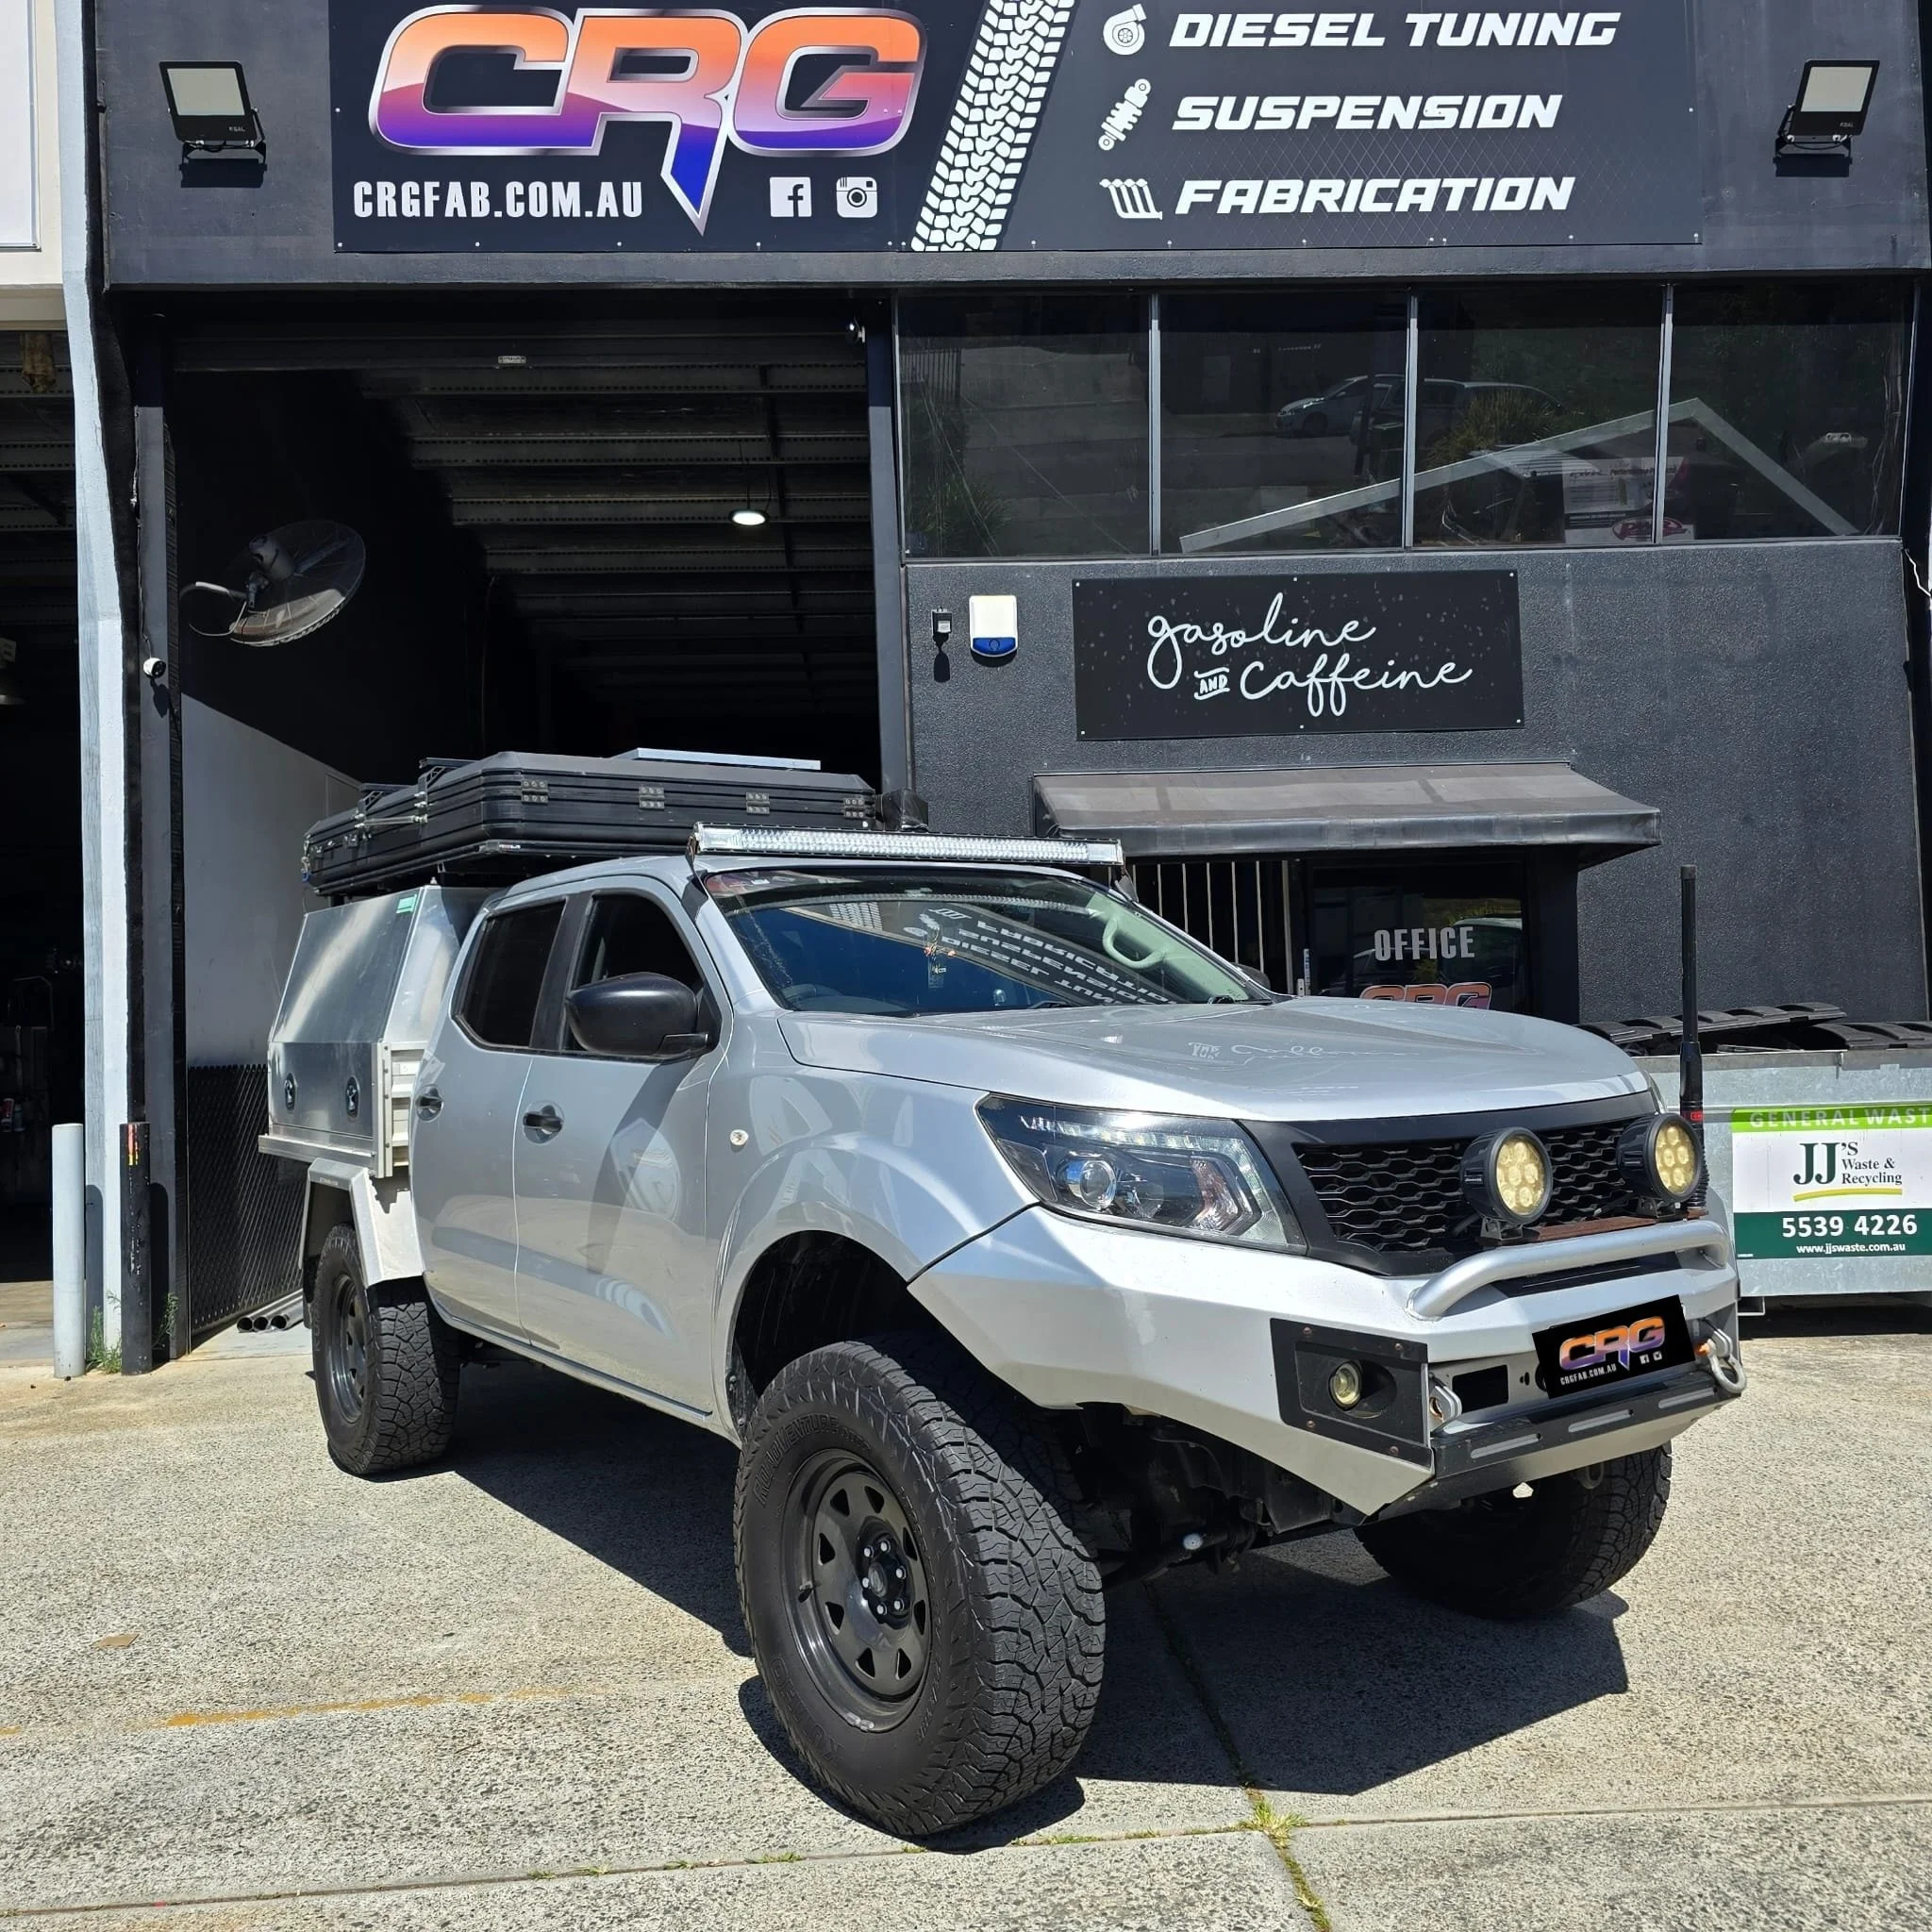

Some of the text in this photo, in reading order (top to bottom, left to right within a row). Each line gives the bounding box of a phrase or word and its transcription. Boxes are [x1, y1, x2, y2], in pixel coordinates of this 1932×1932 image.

[1168, 11, 1622, 48] DIESEL TUNING
[368, 4, 927, 236] CRG
[1172, 93, 1564, 130] SUSPENSION
[353, 179, 643, 220] CRGFAB.COM.AU
[1174, 176, 1576, 215] FABRICATION
[1146, 592, 1376, 690] gasoline
[1196, 671, 1228, 696] AND
[1374, 926, 1475, 961] OFFICE
[1749, 1109, 1859, 1128] GENERAL
[1840, 1158, 1895, 1170] Waste &
[1840, 1172, 1903, 1186] Recycling
[1782, 1214, 1918, 1238] 5539 4226
[1796, 1242, 1906, 1255] www.jjswaste.com.au
[1559, 1316, 1666, 1372] CRG
[1559, 1363, 1618, 1386] CRGFAB.COM.AU
